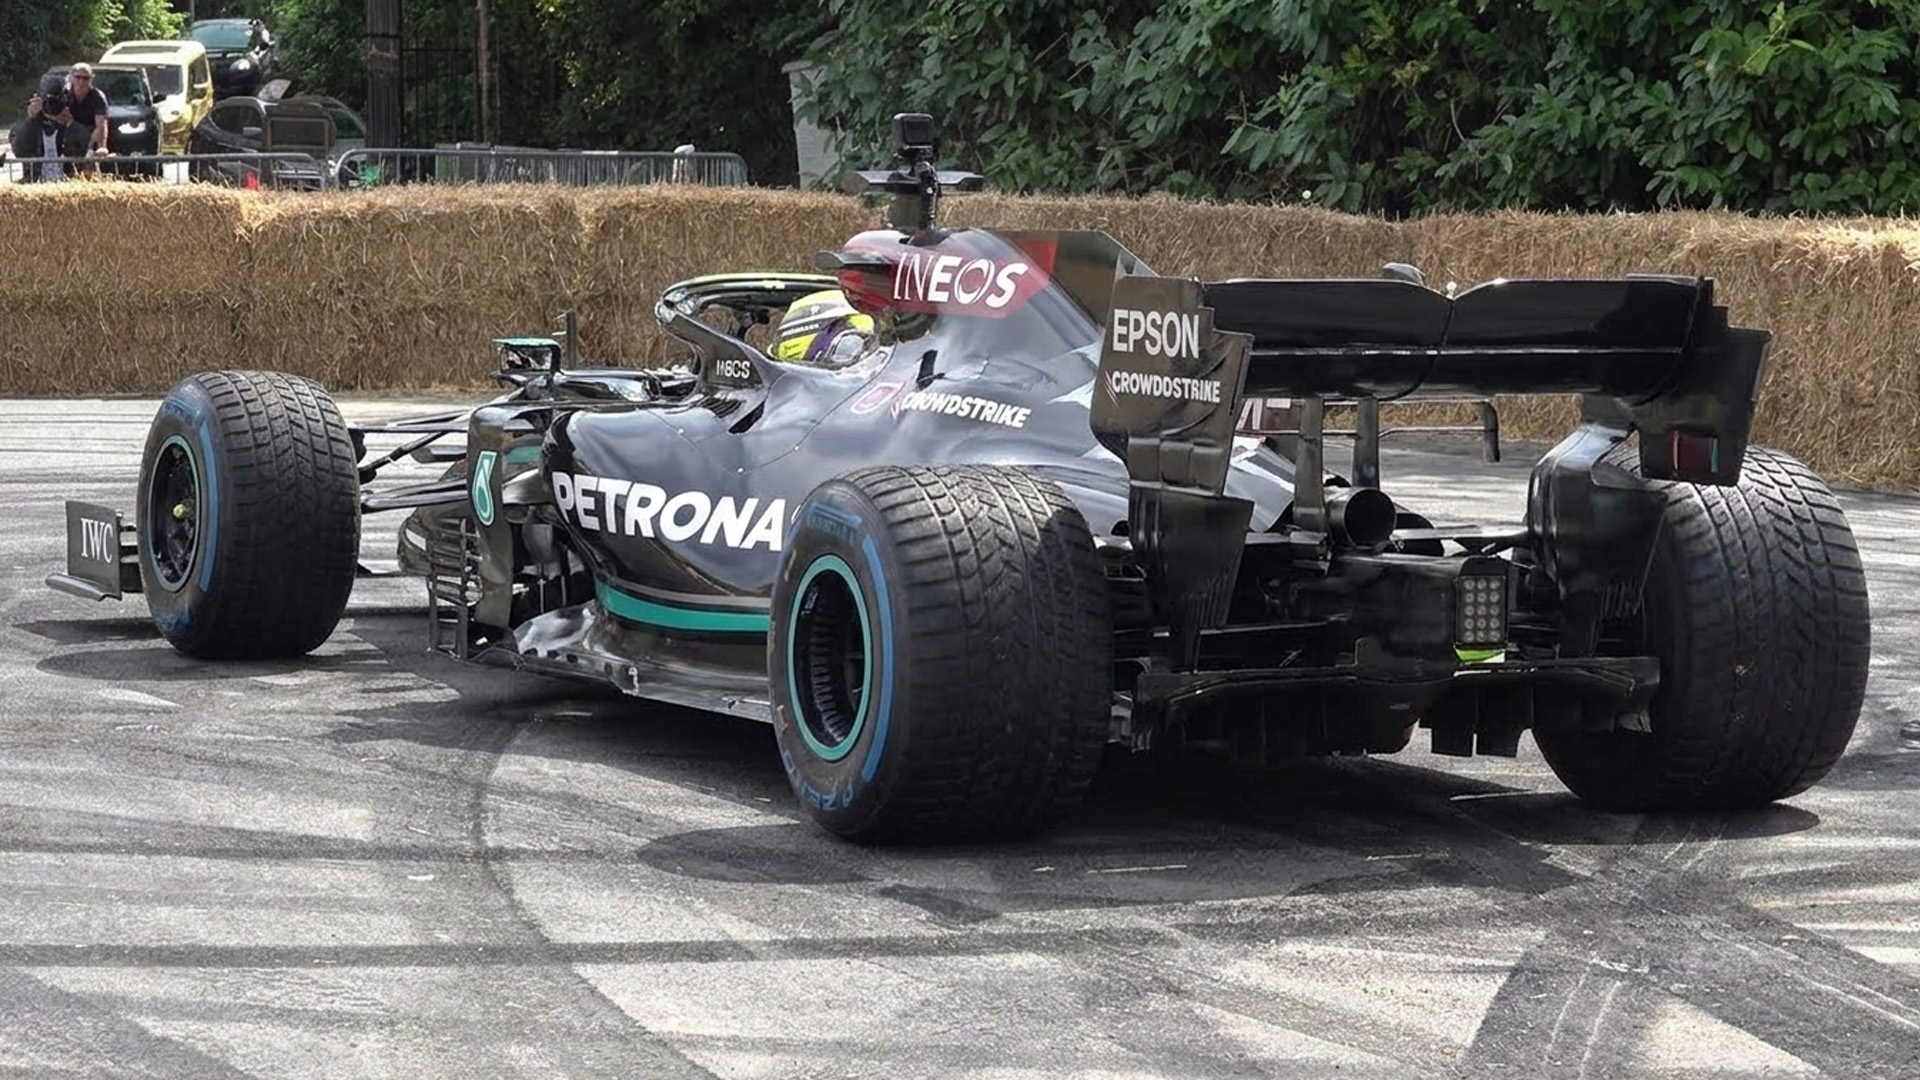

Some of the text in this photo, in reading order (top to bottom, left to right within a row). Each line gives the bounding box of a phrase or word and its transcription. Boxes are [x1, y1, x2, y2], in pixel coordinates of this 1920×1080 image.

[893, 252, 1029, 309] INEOS
[1112, 308, 1200, 359] EPSON
[552, 471, 800, 552] PETRONA
[80, 517, 114, 564] IWC
